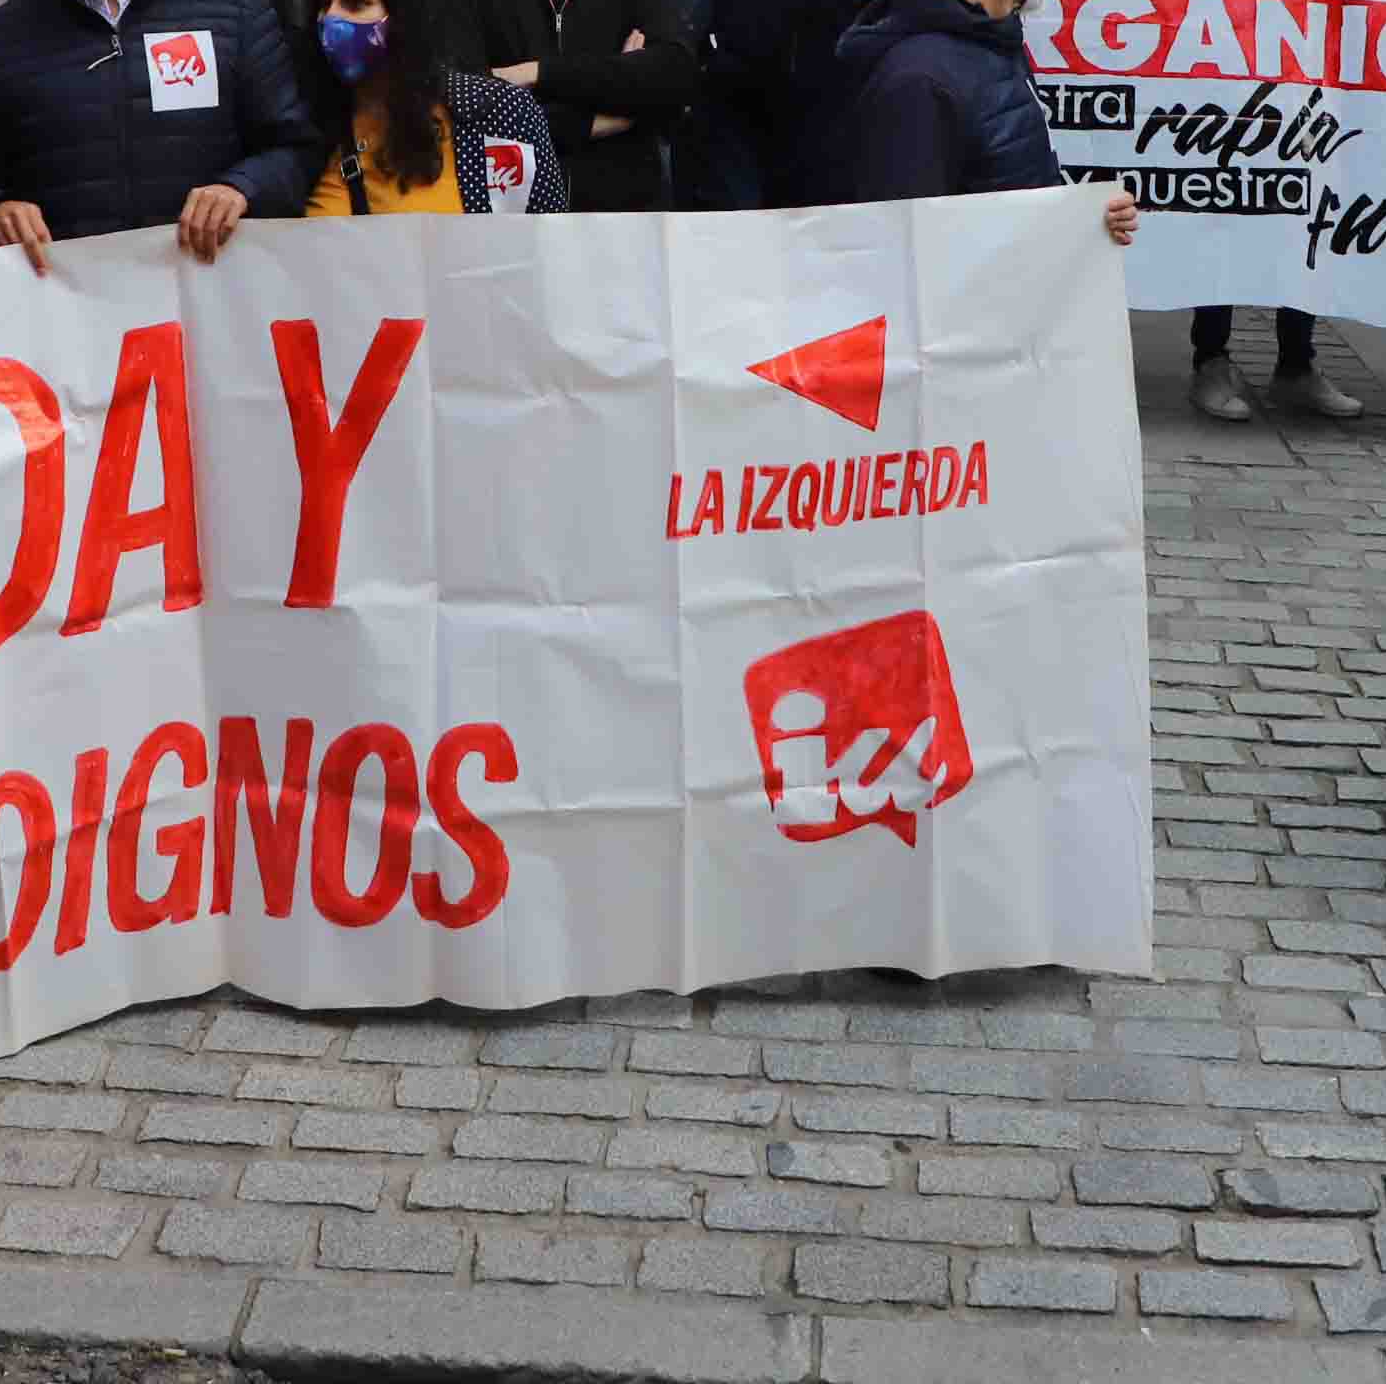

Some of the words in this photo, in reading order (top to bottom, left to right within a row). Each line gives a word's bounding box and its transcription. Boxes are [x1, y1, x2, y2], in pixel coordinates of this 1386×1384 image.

[1135, 81, 1362, 168] rabia
[269, 318, 425, 608] Y
[666, 472, 723, 541] LA
[736, 440, 989, 533] IZQUIERDA
